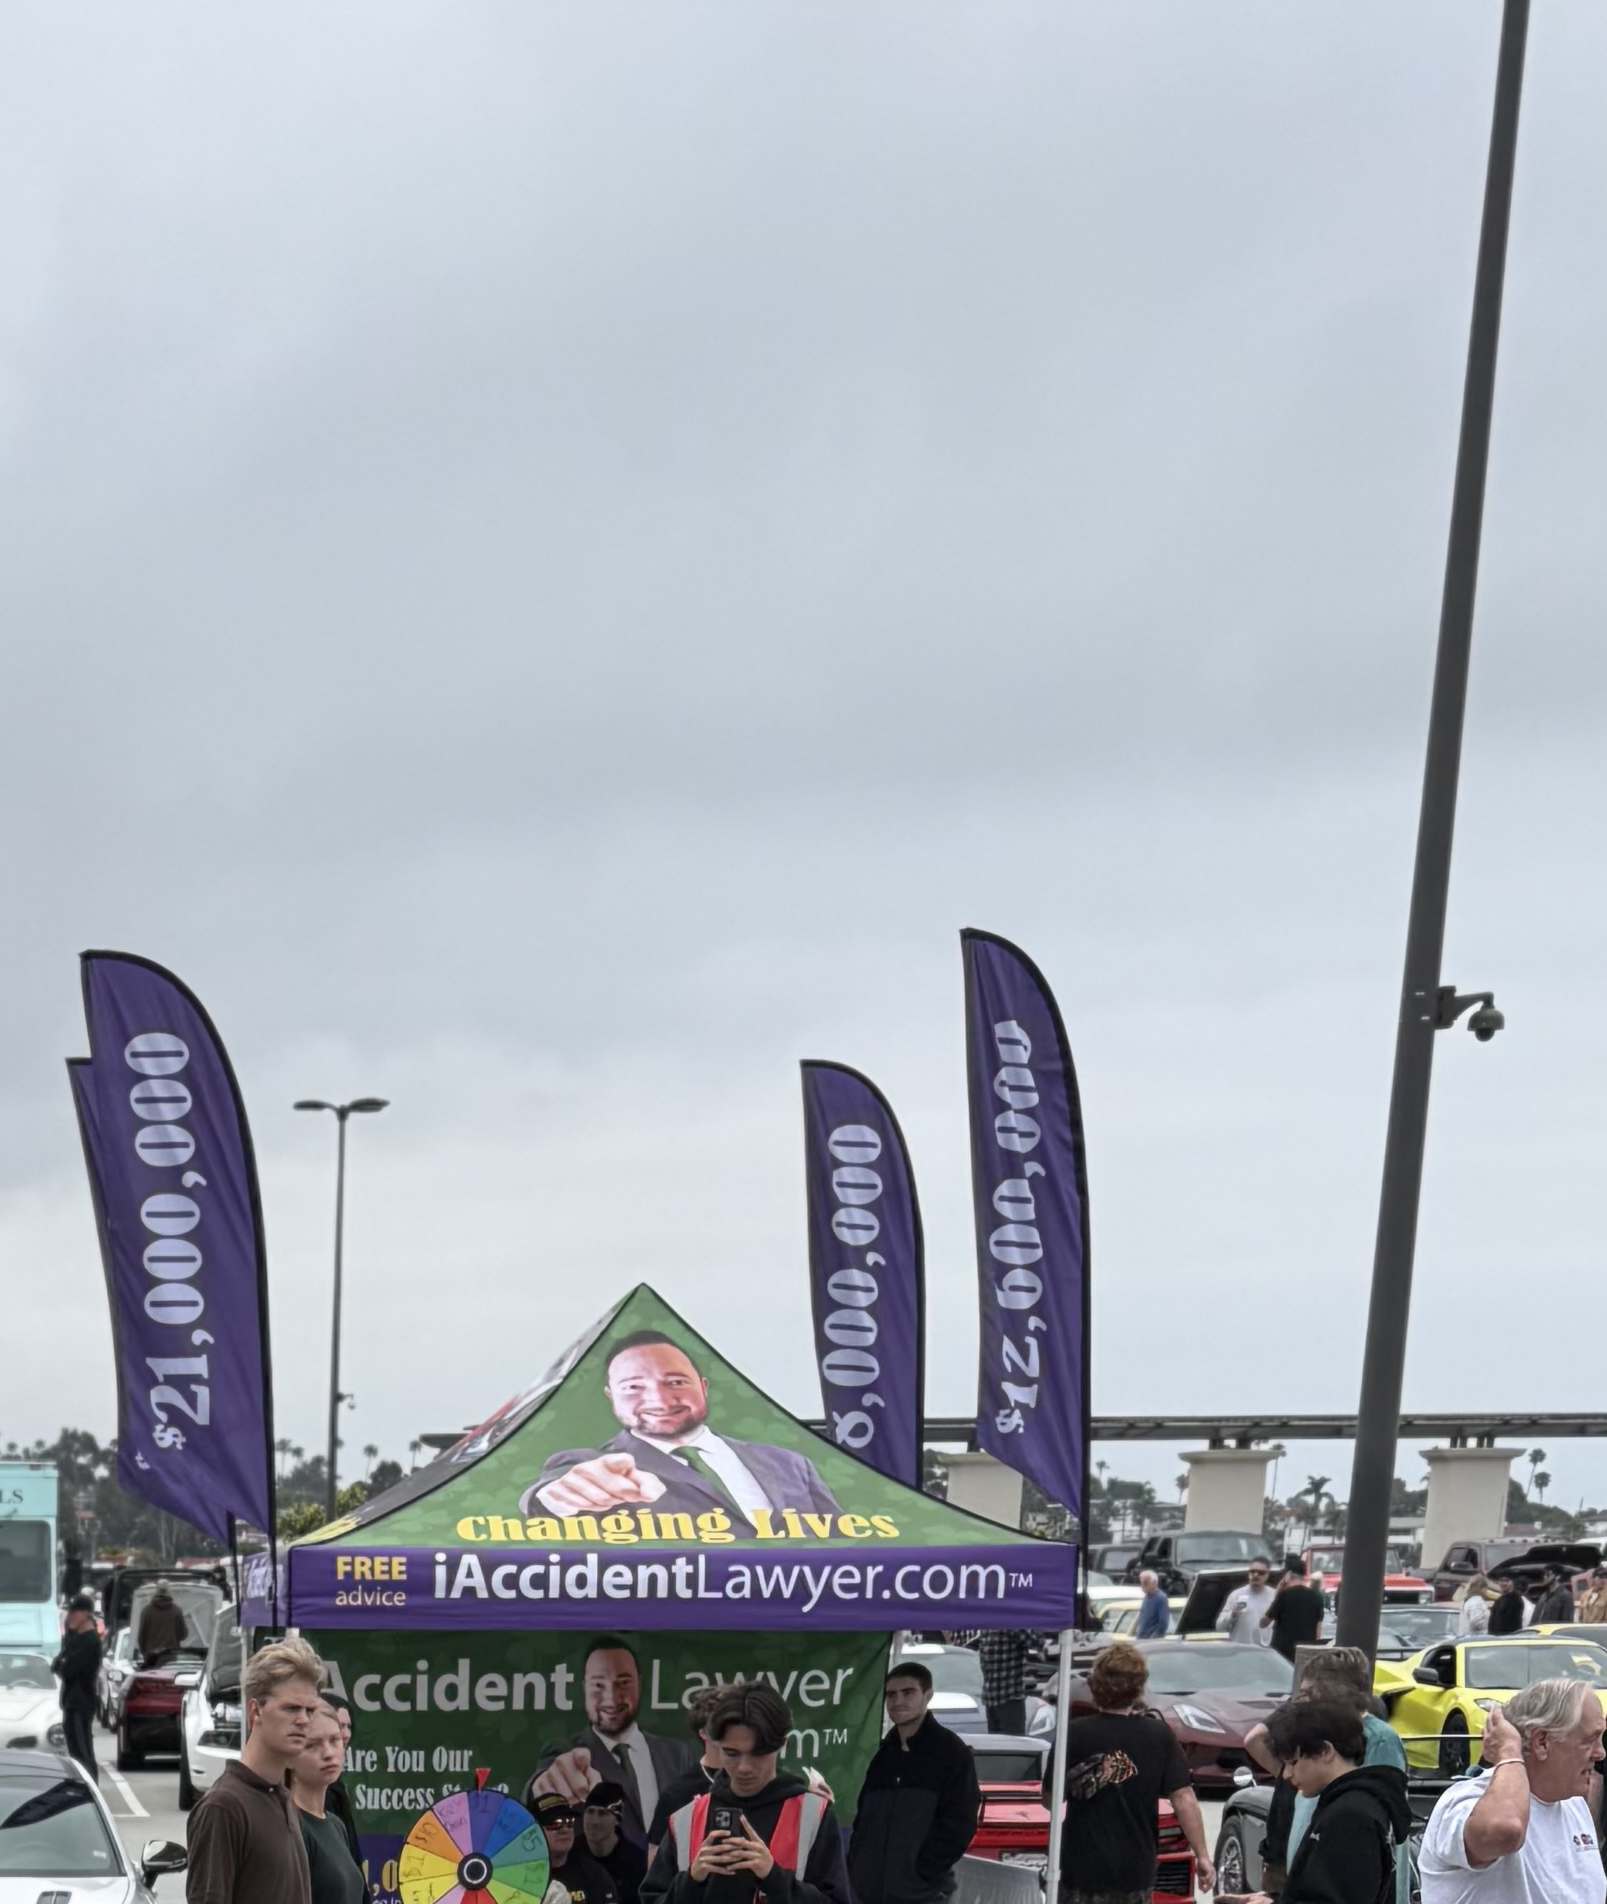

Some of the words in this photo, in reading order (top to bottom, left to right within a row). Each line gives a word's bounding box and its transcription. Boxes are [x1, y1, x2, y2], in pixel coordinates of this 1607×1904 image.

[124, 1031, 214, 1451] $21,000,000
[754, 1507, 900, 1541] Lives
[336, 1556, 408, 1581] FREE
[335, 1585, 407, 1606] advice
[384, 1746, 425, 1772] You
[432, 1745, 473, 1773] Our
[355, 1783, 435, 1810] Success
